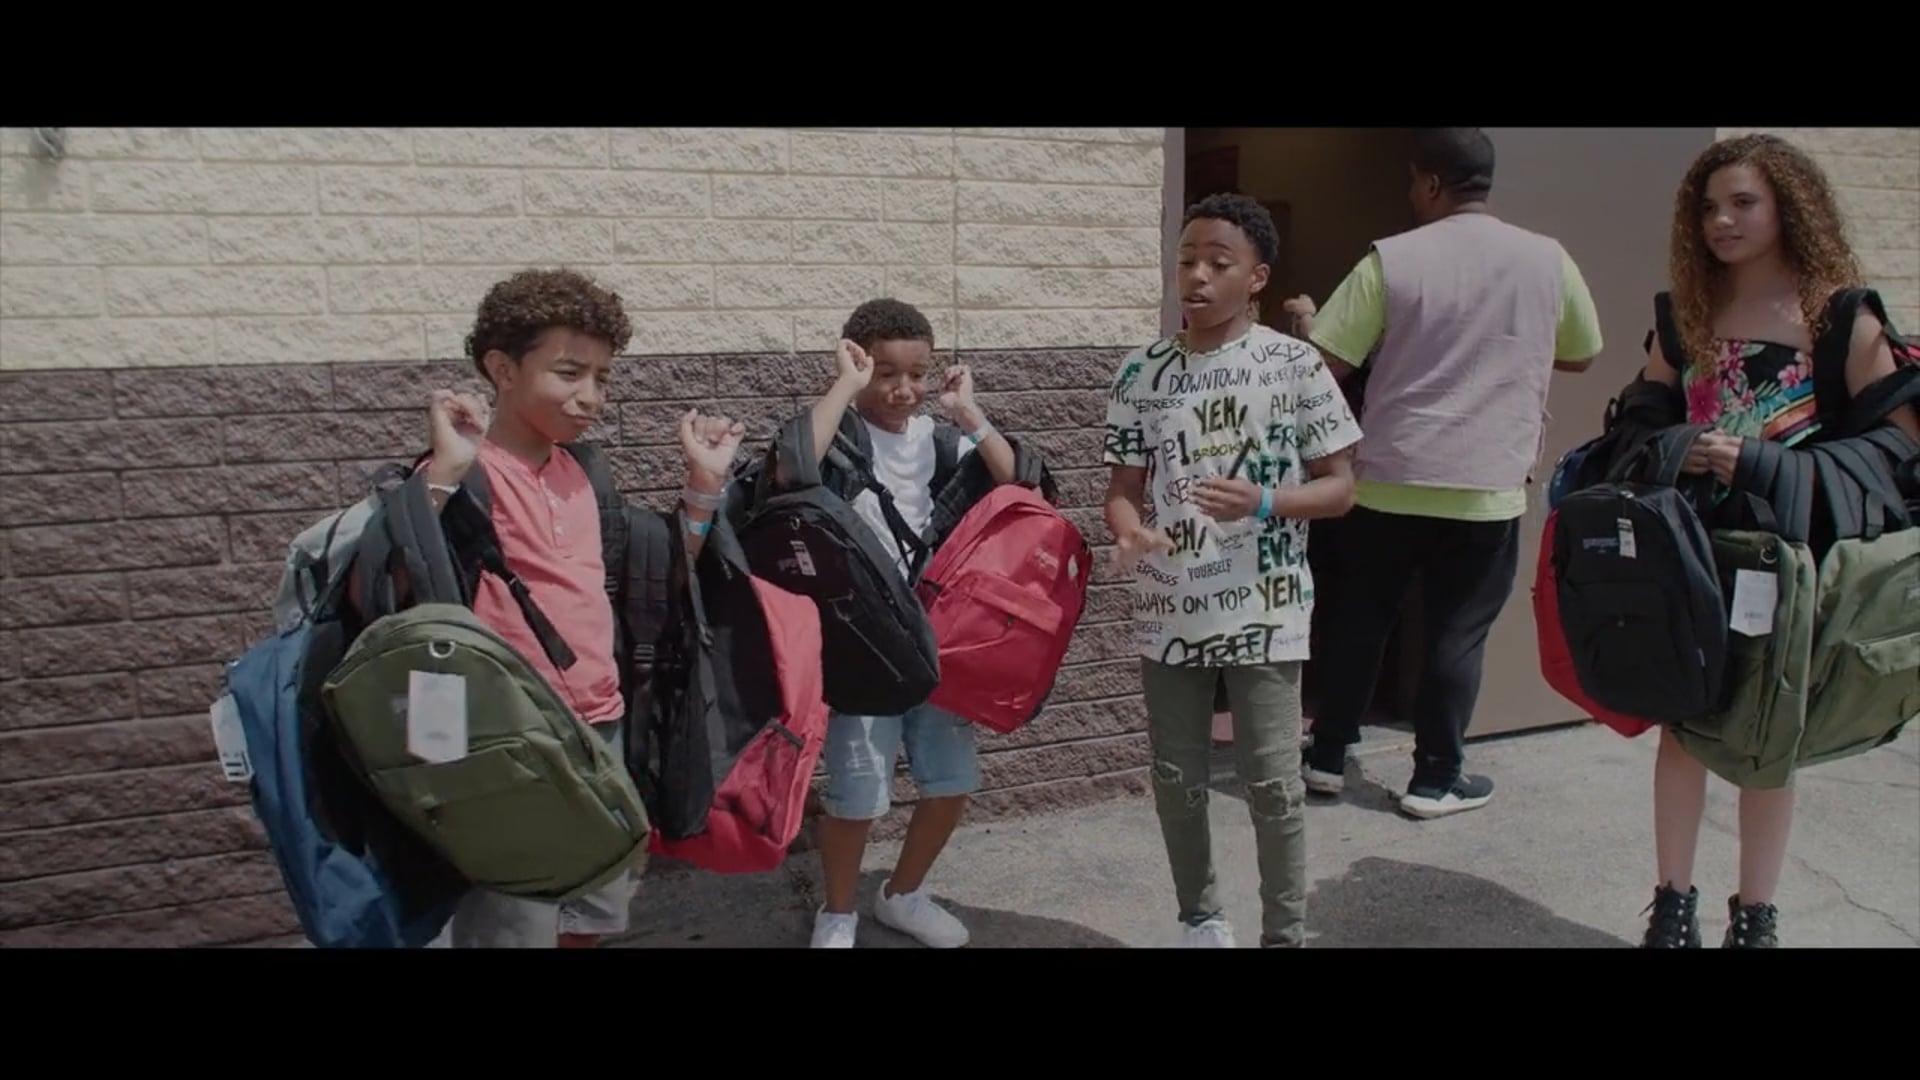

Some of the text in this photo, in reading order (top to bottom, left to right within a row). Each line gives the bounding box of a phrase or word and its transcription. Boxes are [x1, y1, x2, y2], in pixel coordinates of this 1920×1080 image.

[1168, 367, 1251, 396] DOWNTOWN
[1187, 557, 1232, 581] YOURSELF
[1182, 594, 1208, 615] ON
[1212, 586, 1252, 612] TOP
